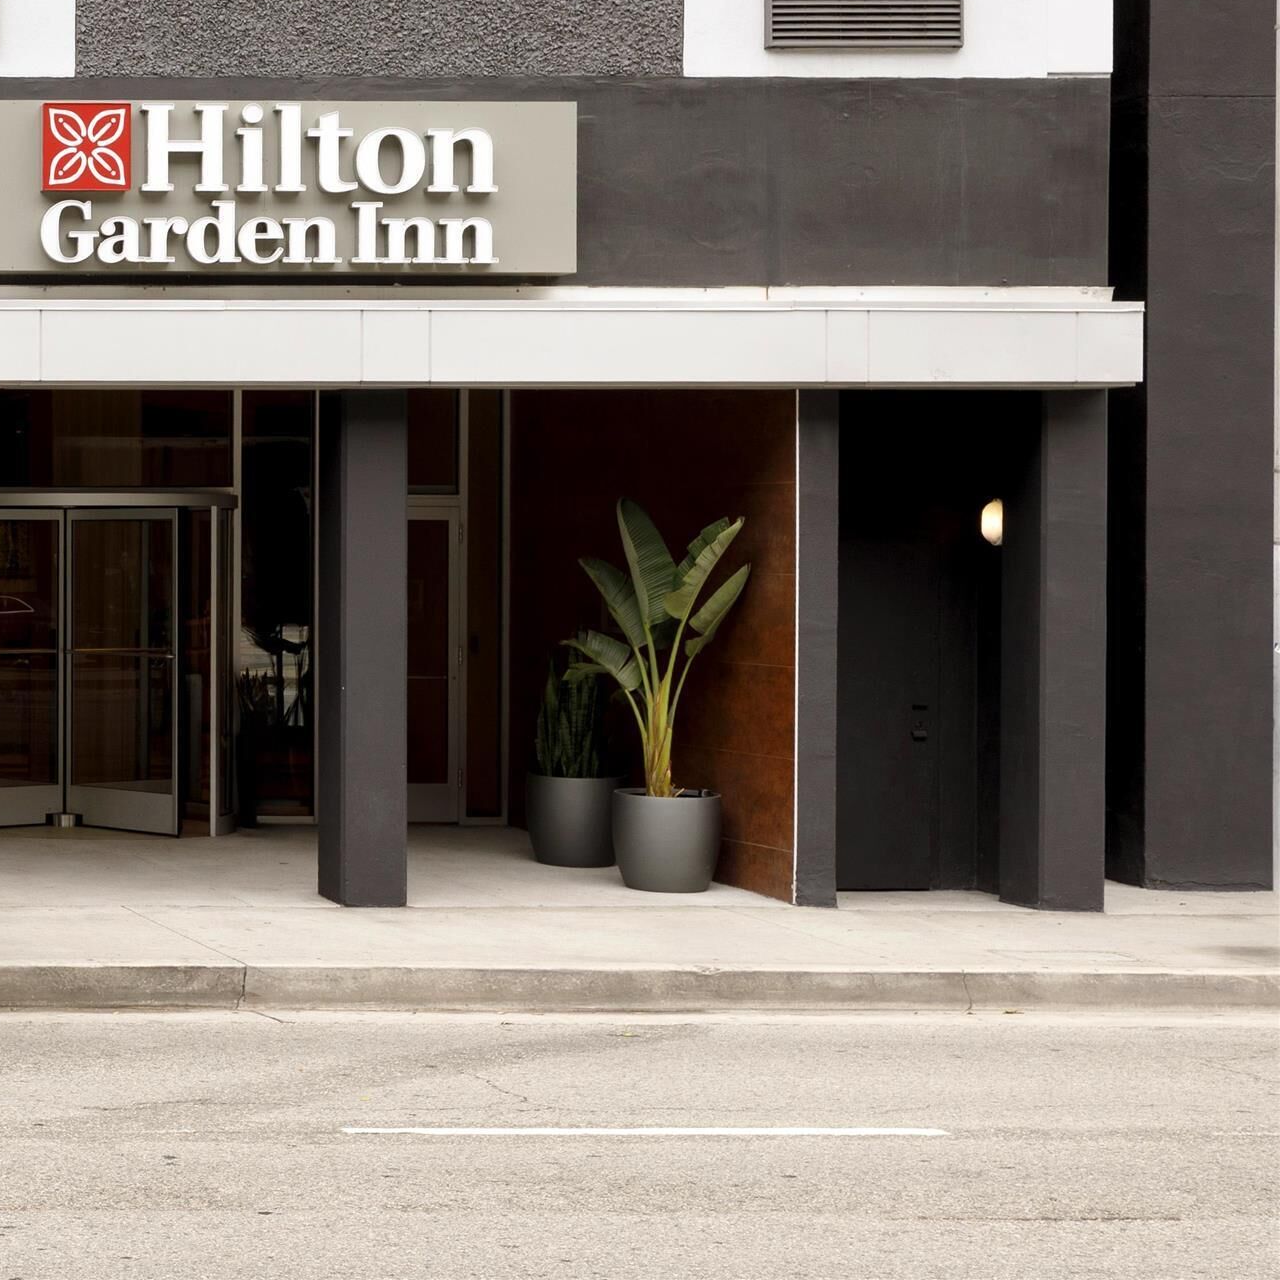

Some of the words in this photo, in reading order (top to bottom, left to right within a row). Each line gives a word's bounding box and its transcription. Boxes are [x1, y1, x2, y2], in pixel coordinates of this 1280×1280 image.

[139, 101, 499, 195] Hilton
[39, 199, 343, 265] Garden
[350, 199, 500, 265] Inn
